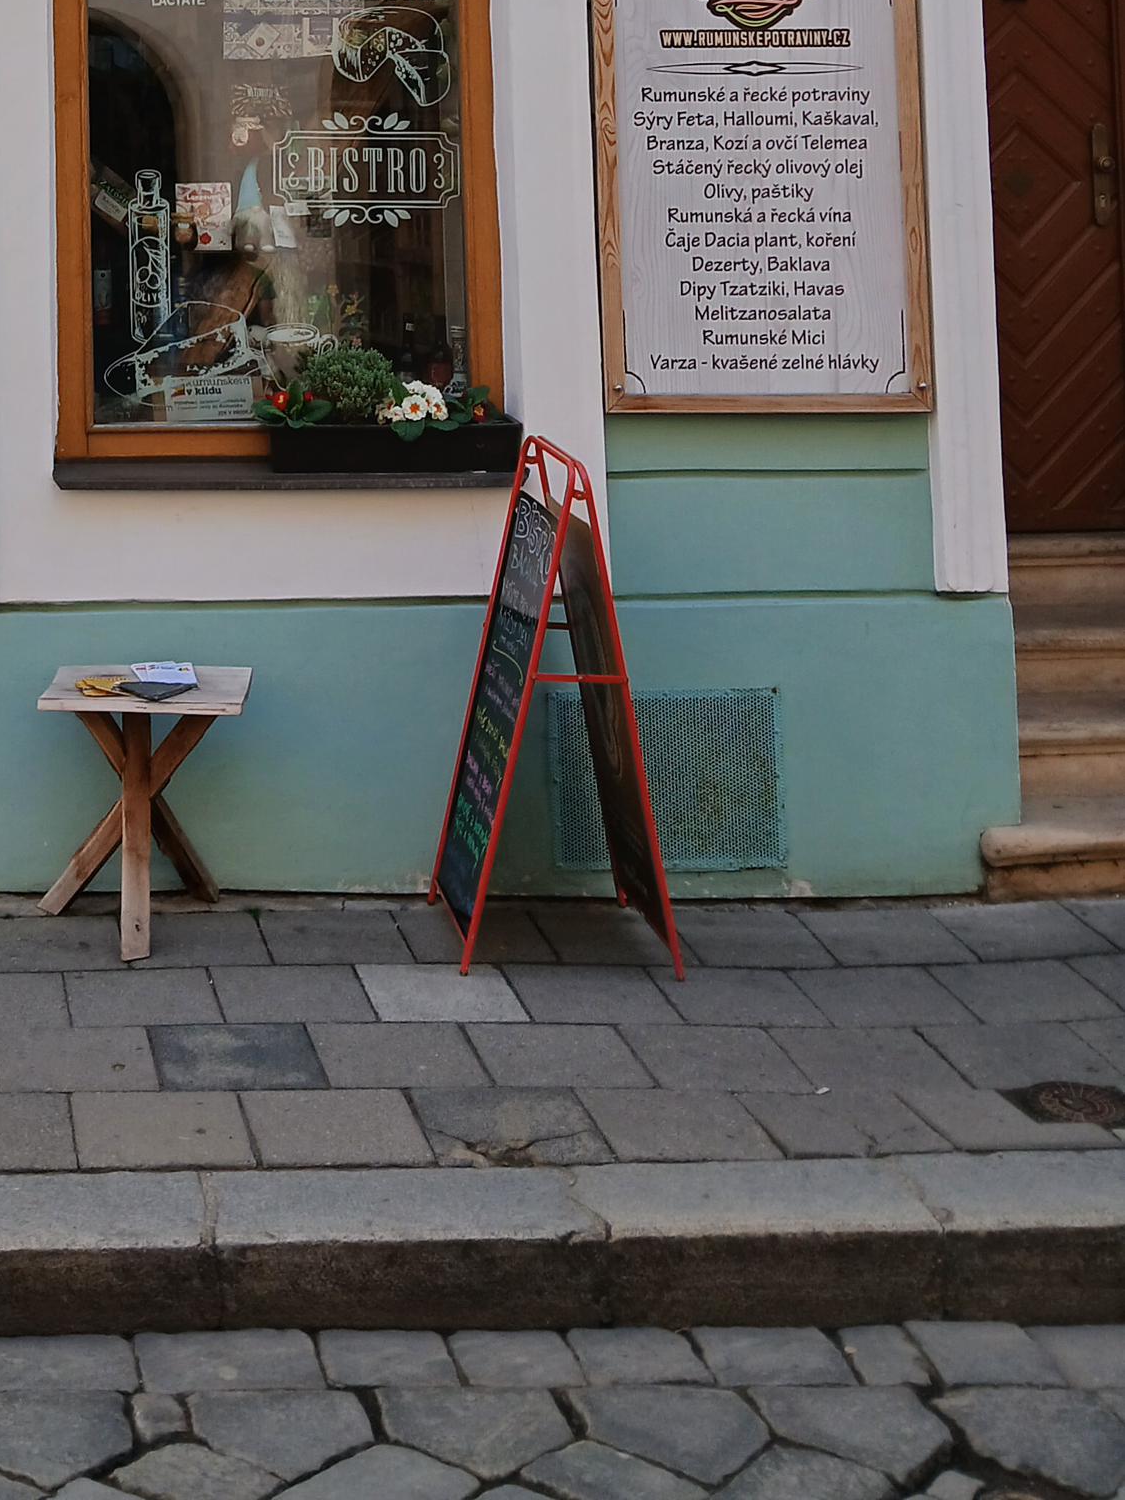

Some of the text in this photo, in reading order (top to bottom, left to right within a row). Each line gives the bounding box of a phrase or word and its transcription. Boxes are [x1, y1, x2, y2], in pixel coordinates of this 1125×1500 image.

[661, 30, 851, 47] WWW.RUMUNSKEPOTRAVINY.CZ
[641, 86, 870, 108] Rumunské a řecké potraviny
[634, 110, 879, 130] Sýry Feta, Halloumi, Kaškaval,
[646, 134, 867, 152] Branza, Kozí a ovčí Telemea
[307, 146, 430, 194] BISTRO
[653, 158, 863, 179] Stáčený řecký olivový olej
[704, 183, 814, 204] Olivy, paštiky
[667, 207, 852, 223] Rumunská a řecká vína
[665, 228, 857, 253] Čaje Dacia plant, koření
[692, 256, 831, 275] Dezerty, Baklava
[680, 280, 845, 302] Dipy Tzatziki, Havas
[695, 305, 831, 321] Melitzanosalata
[702, 329, 826, 345] Rumunské Mici
[650, 354, 697, 370] Varza
[712, 354, 778, 370] kvašené
[782, 354, 824, 370] zelné
[828, 354, 880, 373] hlávky
